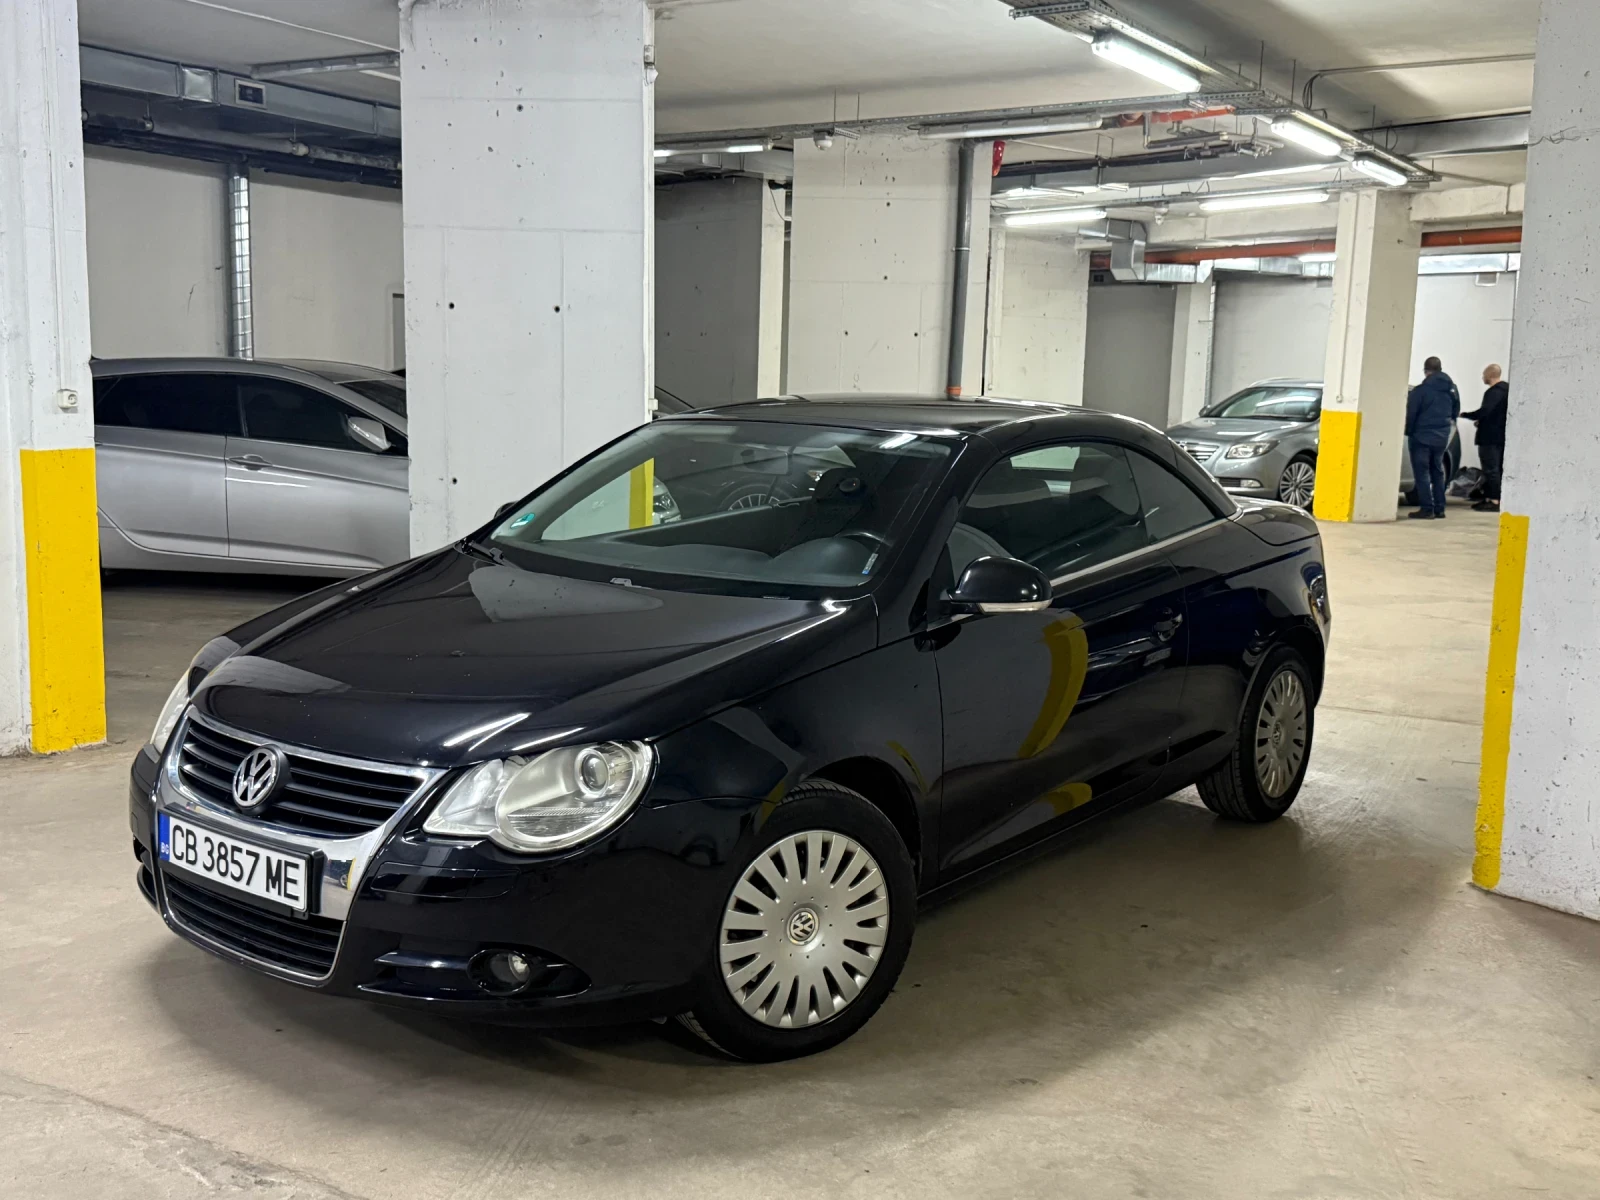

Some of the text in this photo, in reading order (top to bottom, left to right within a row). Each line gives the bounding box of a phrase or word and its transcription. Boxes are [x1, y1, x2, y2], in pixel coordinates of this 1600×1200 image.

[233, 748, 277, 806] VW
[160, 841, 170, 855] BG
[172, 824, 300, 902] CB 3857 ME
